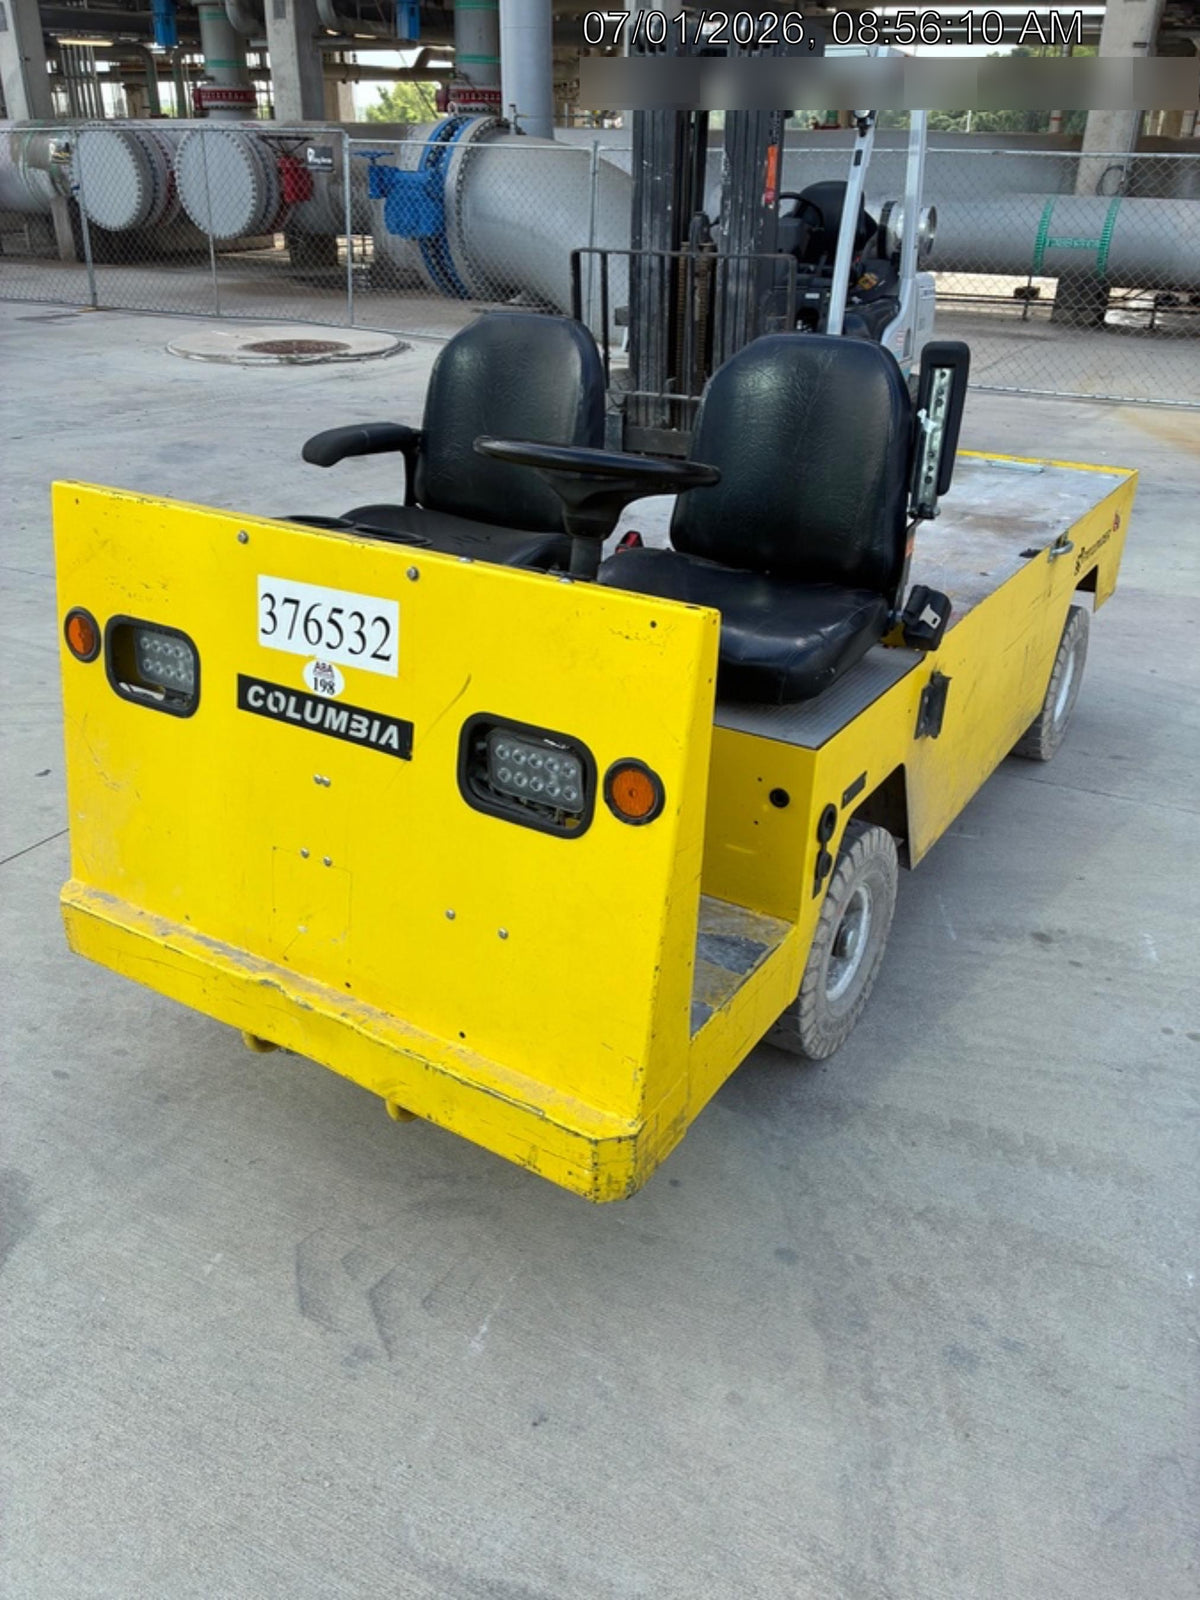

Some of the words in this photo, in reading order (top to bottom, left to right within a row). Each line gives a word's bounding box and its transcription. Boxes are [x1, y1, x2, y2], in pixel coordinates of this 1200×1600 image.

[260, 592, 392, 662] 376532
[246, 685, 400, 750] COLUMBIA
[313, 676, 336, 696] 198
